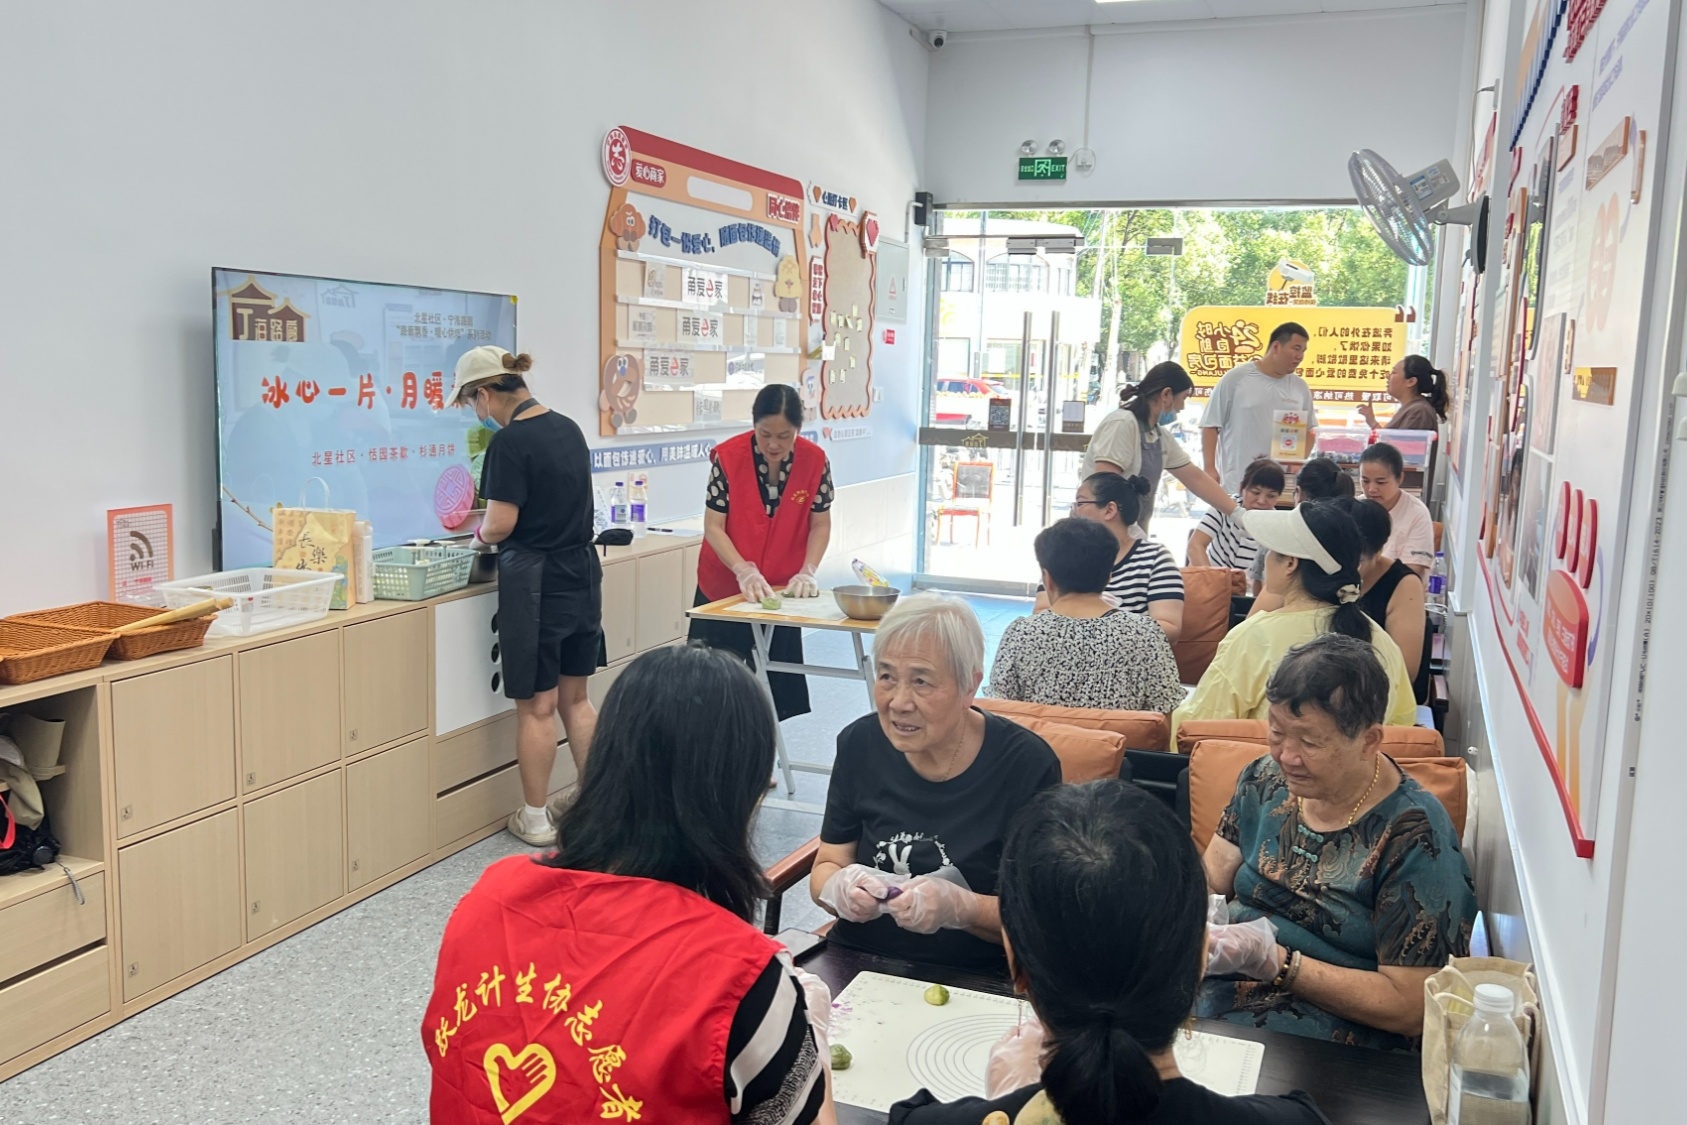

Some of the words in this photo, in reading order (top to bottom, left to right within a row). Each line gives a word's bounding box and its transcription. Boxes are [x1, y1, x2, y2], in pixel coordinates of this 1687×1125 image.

[635, 162, 665, 184] 爱心商家
[1051, 164, 1066, 173] EXIT
[261, 371, 461, 411] 冰心一片·月暖
